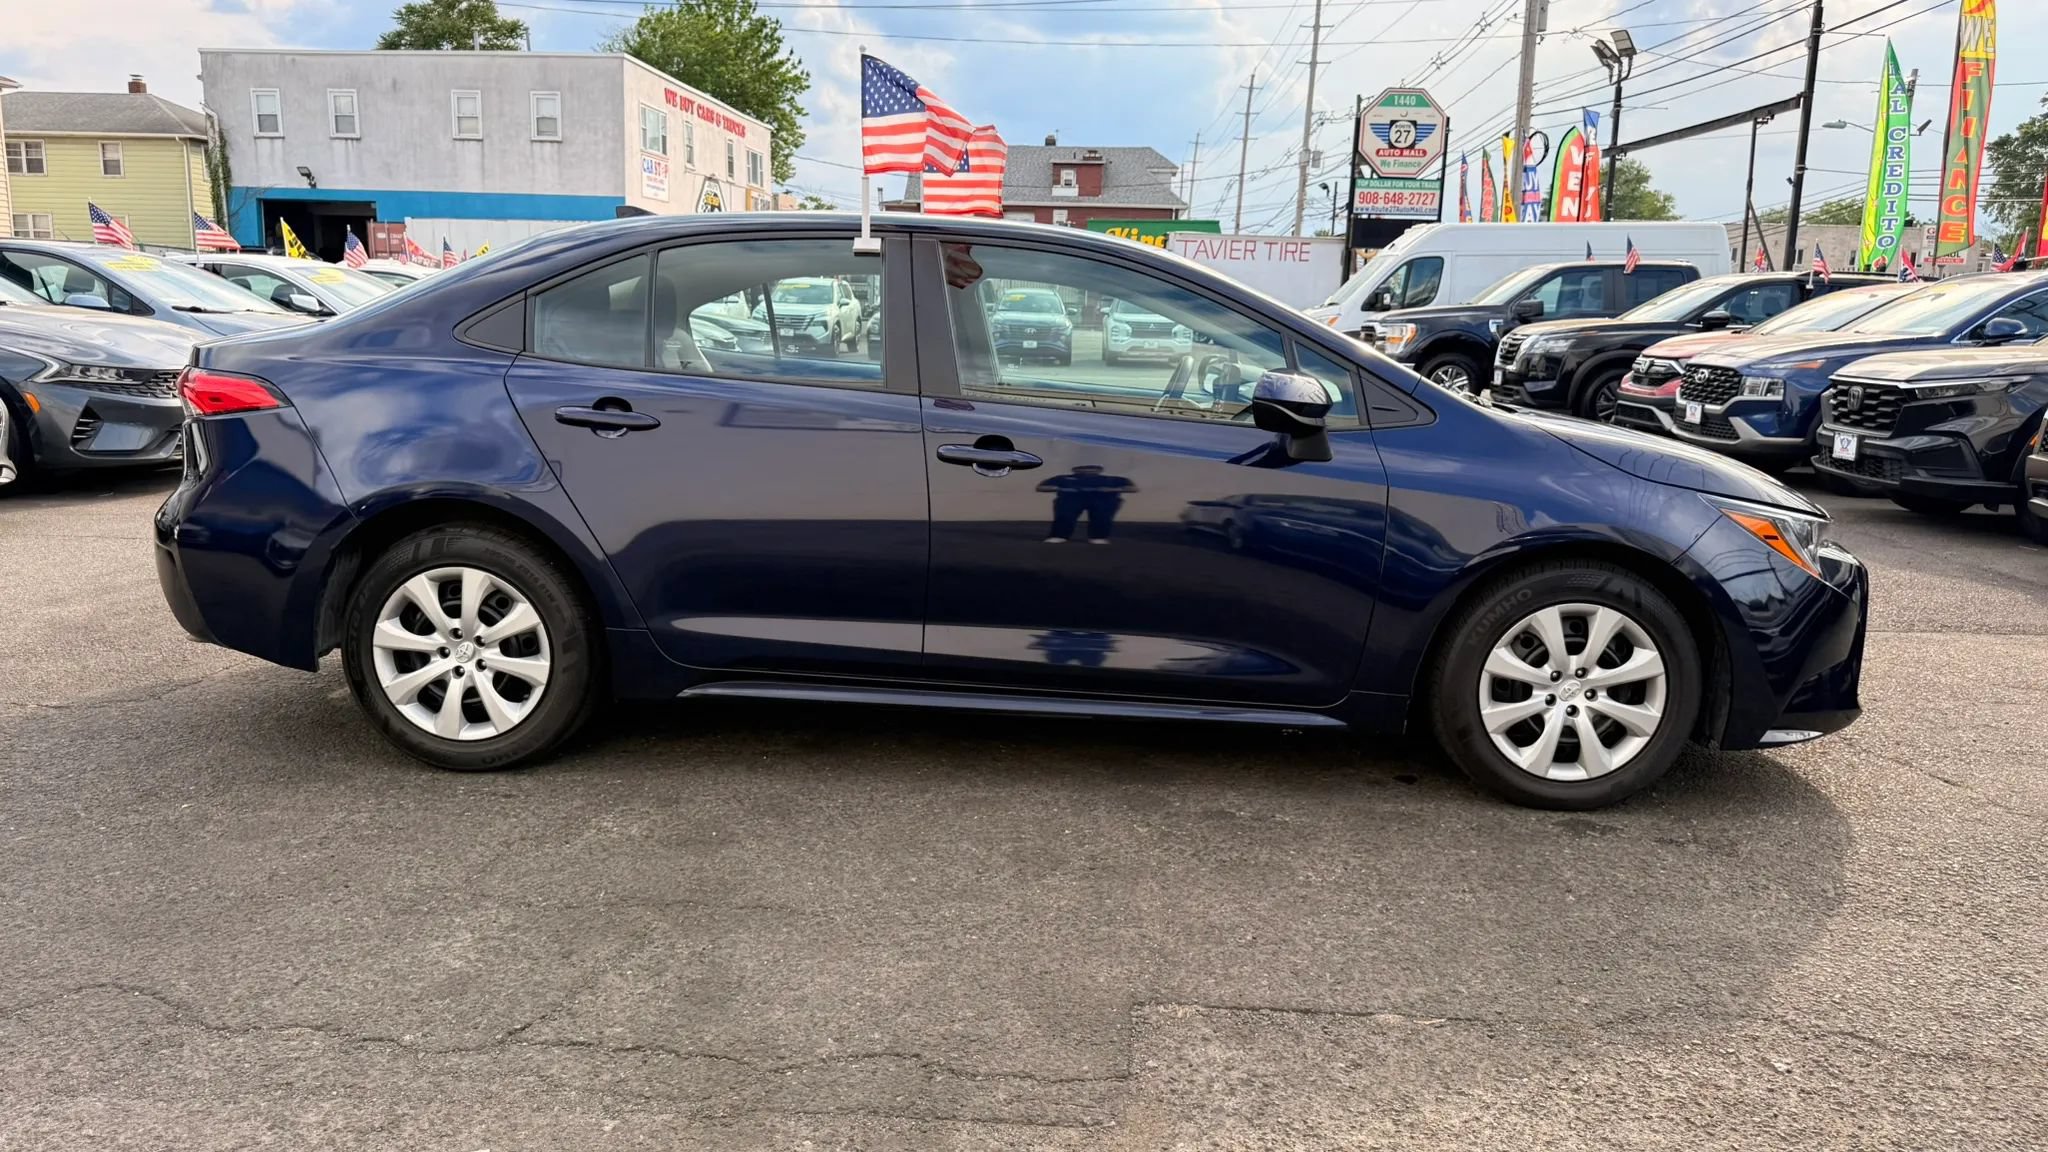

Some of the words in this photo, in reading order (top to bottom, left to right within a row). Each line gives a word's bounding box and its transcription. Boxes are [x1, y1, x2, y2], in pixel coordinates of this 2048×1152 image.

[1959, 15, 1995, 53] WE
[664, 87, 678, 107] WE
[680, 95, 696, 115] BUY
[1394, 95, 1417, 105] 1440
[1394, 129, 1411, 143] 27
[1377, 149, 1401, 157] AUTO
[1402, 149, 1425, 157] MALL
[642, 158, 654, 174] CAR
[1380, 160, 1391, 168] We
[1392, 159, 1422, 168] Finance
[1369, 180, 1391, 188] DOLLAR
[1392, 180, 1404, 188] FOR
[1876, 127, 1908, 249] CREDITO
[1358, 191, 1436, 206] 908-648-2727
[1176, 239, 1257, 260] TAVIER
[1263, 241, 1311, 262] TIRE
